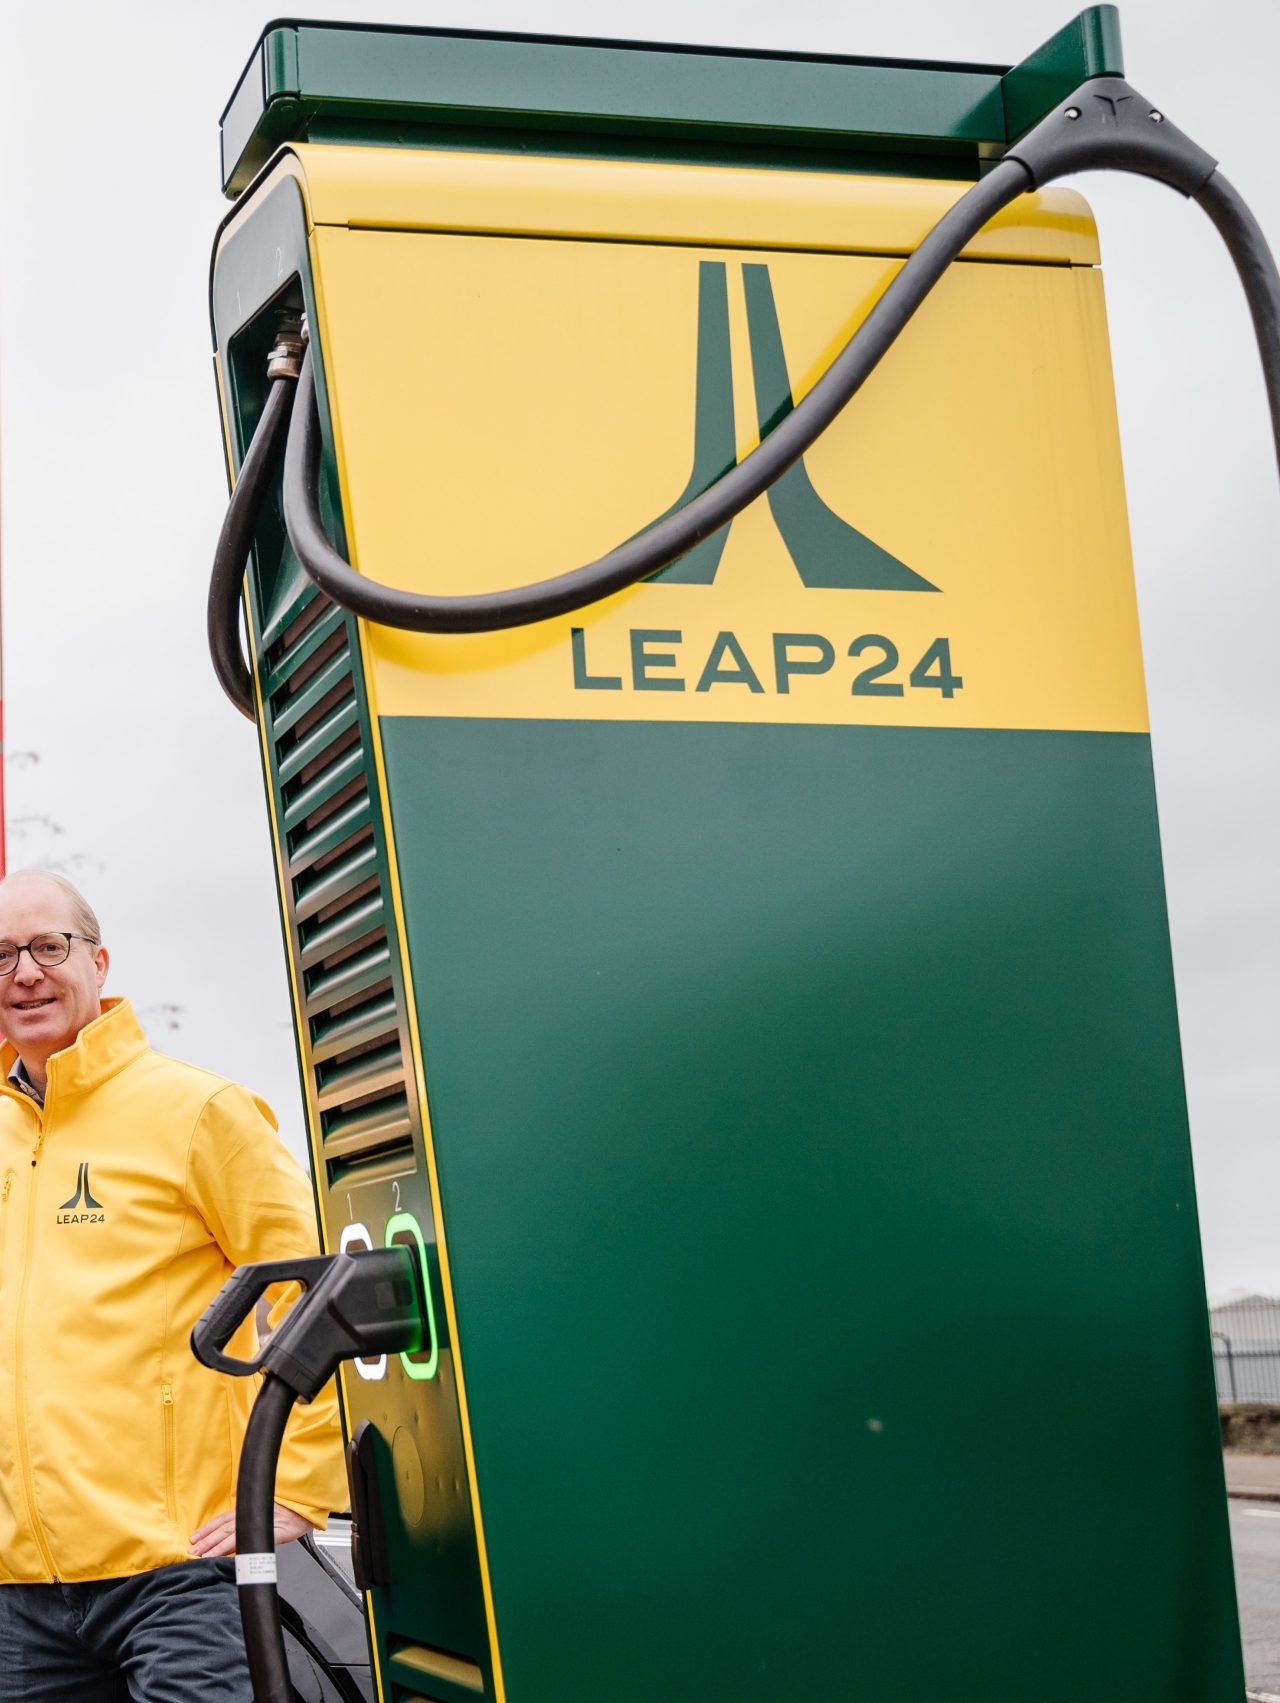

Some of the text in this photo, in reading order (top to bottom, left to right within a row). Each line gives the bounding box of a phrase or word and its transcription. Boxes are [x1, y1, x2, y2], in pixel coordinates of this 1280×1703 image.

[571, 627, 964, 699] LEAP24
[346, 1193, 353, 1220] 1
[392, 1181, 402, 1212] 2
[56, 1213, 105, 1225] LEAP24
